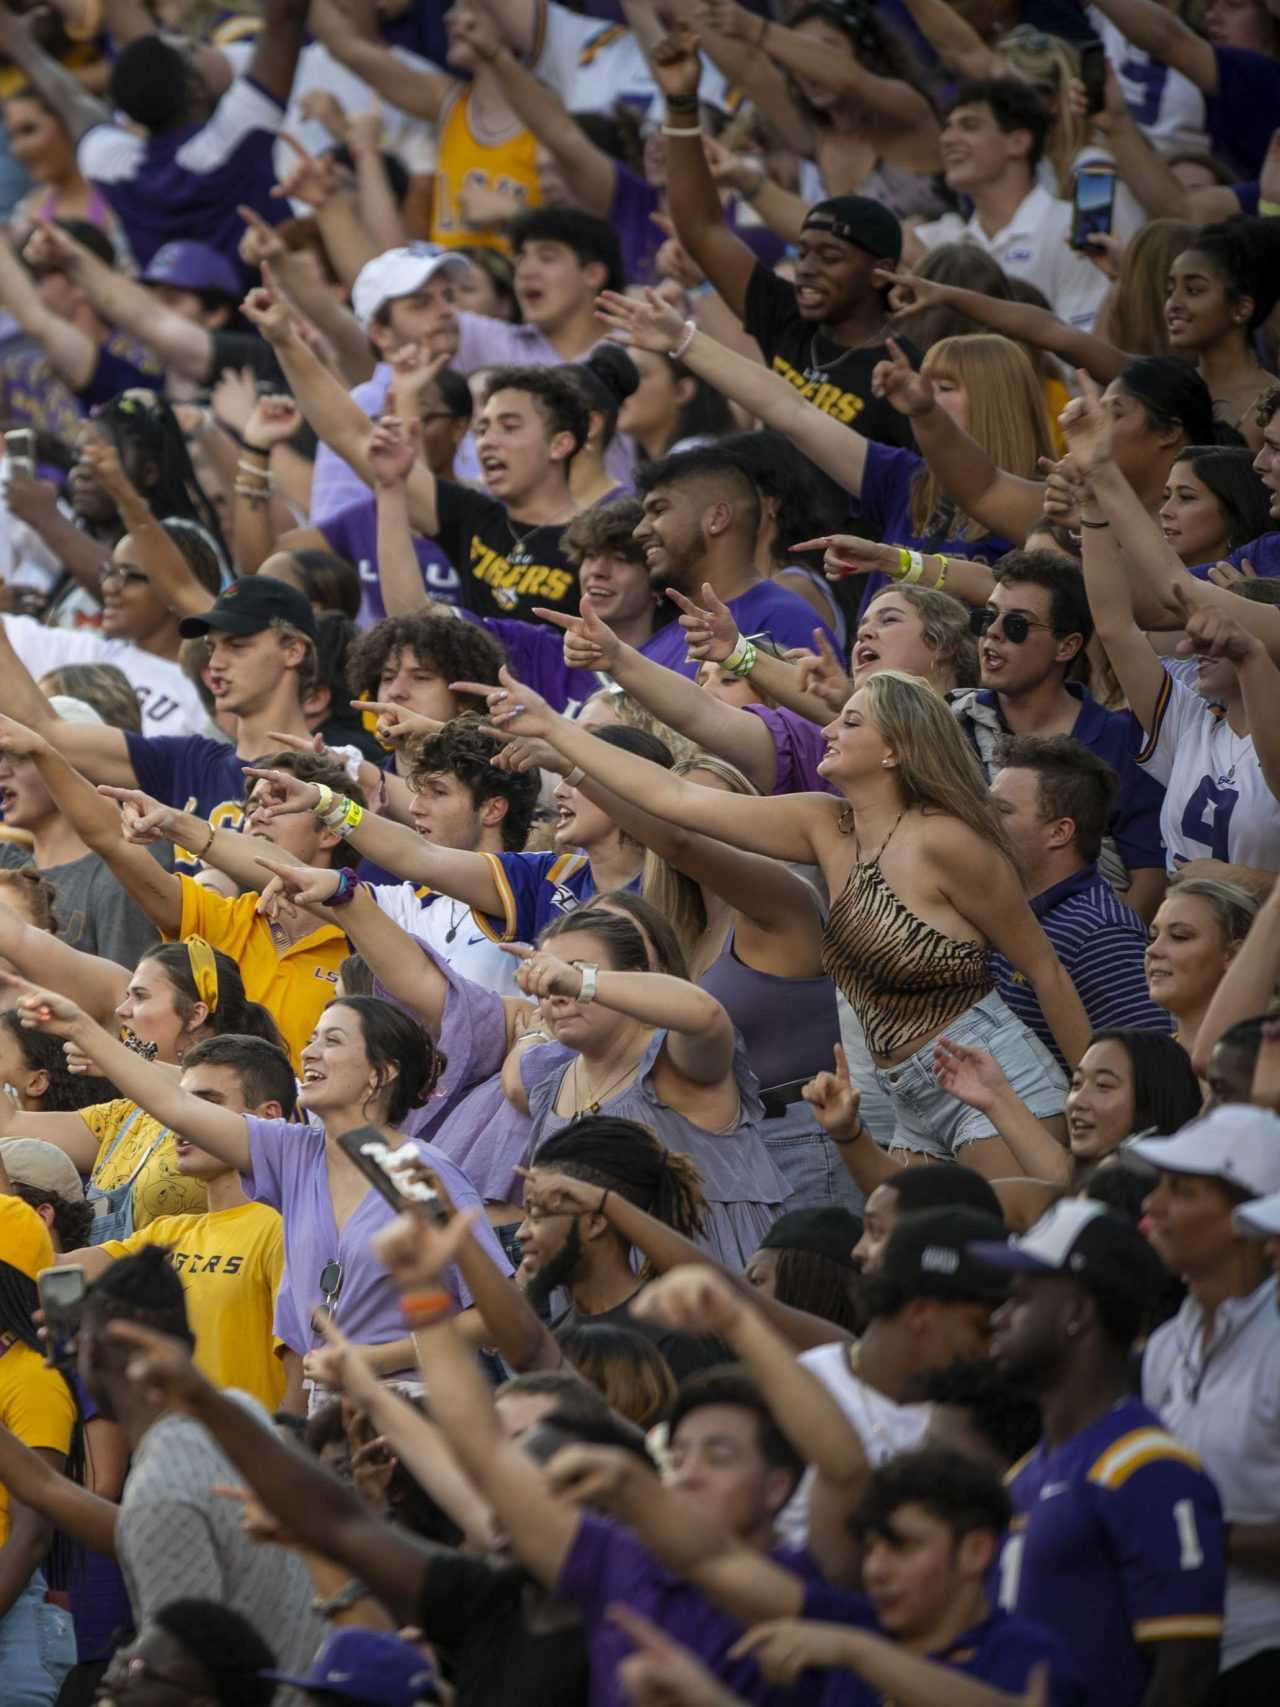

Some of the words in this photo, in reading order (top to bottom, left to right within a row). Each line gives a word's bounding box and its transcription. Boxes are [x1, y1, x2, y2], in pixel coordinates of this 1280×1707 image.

[359, 559, 460, 588] LU
[1173, 774, 1239, 864] 9
[313, 967, 338, 983] LS
[1173, 1499, 1204, 1571] 1
